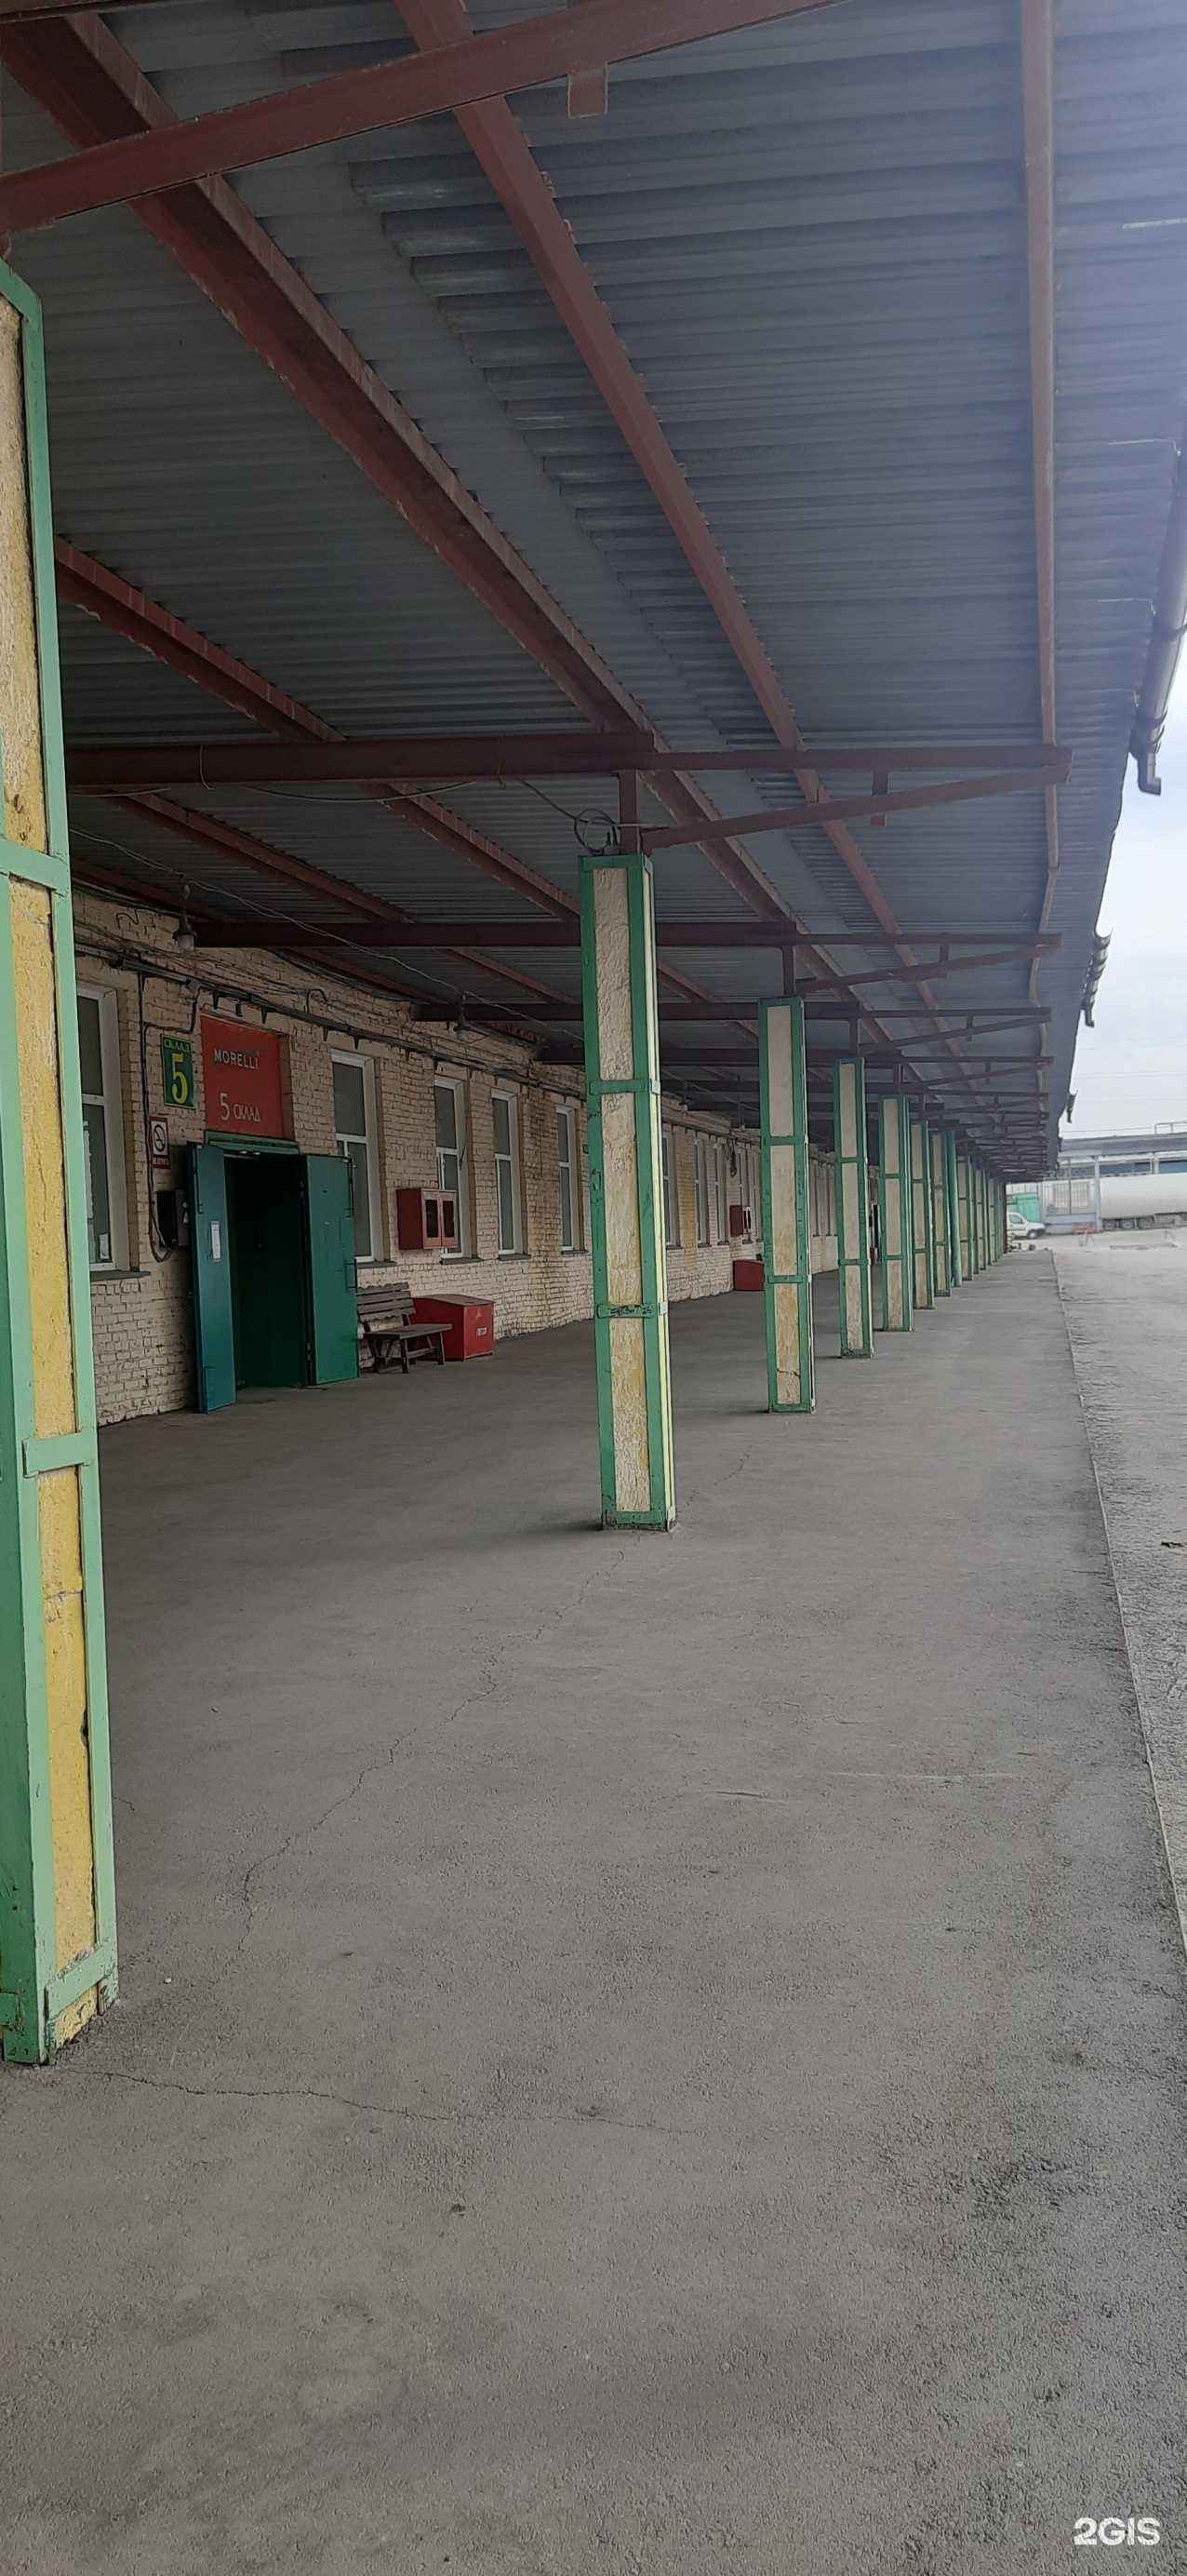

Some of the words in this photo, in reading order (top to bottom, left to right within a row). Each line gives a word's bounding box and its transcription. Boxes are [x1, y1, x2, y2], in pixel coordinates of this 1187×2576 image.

[213, 1048, 260, 1069] MORELLI
[172, 1053, 188, 1103] 5
[220, 1092, 230, 1120] 5
